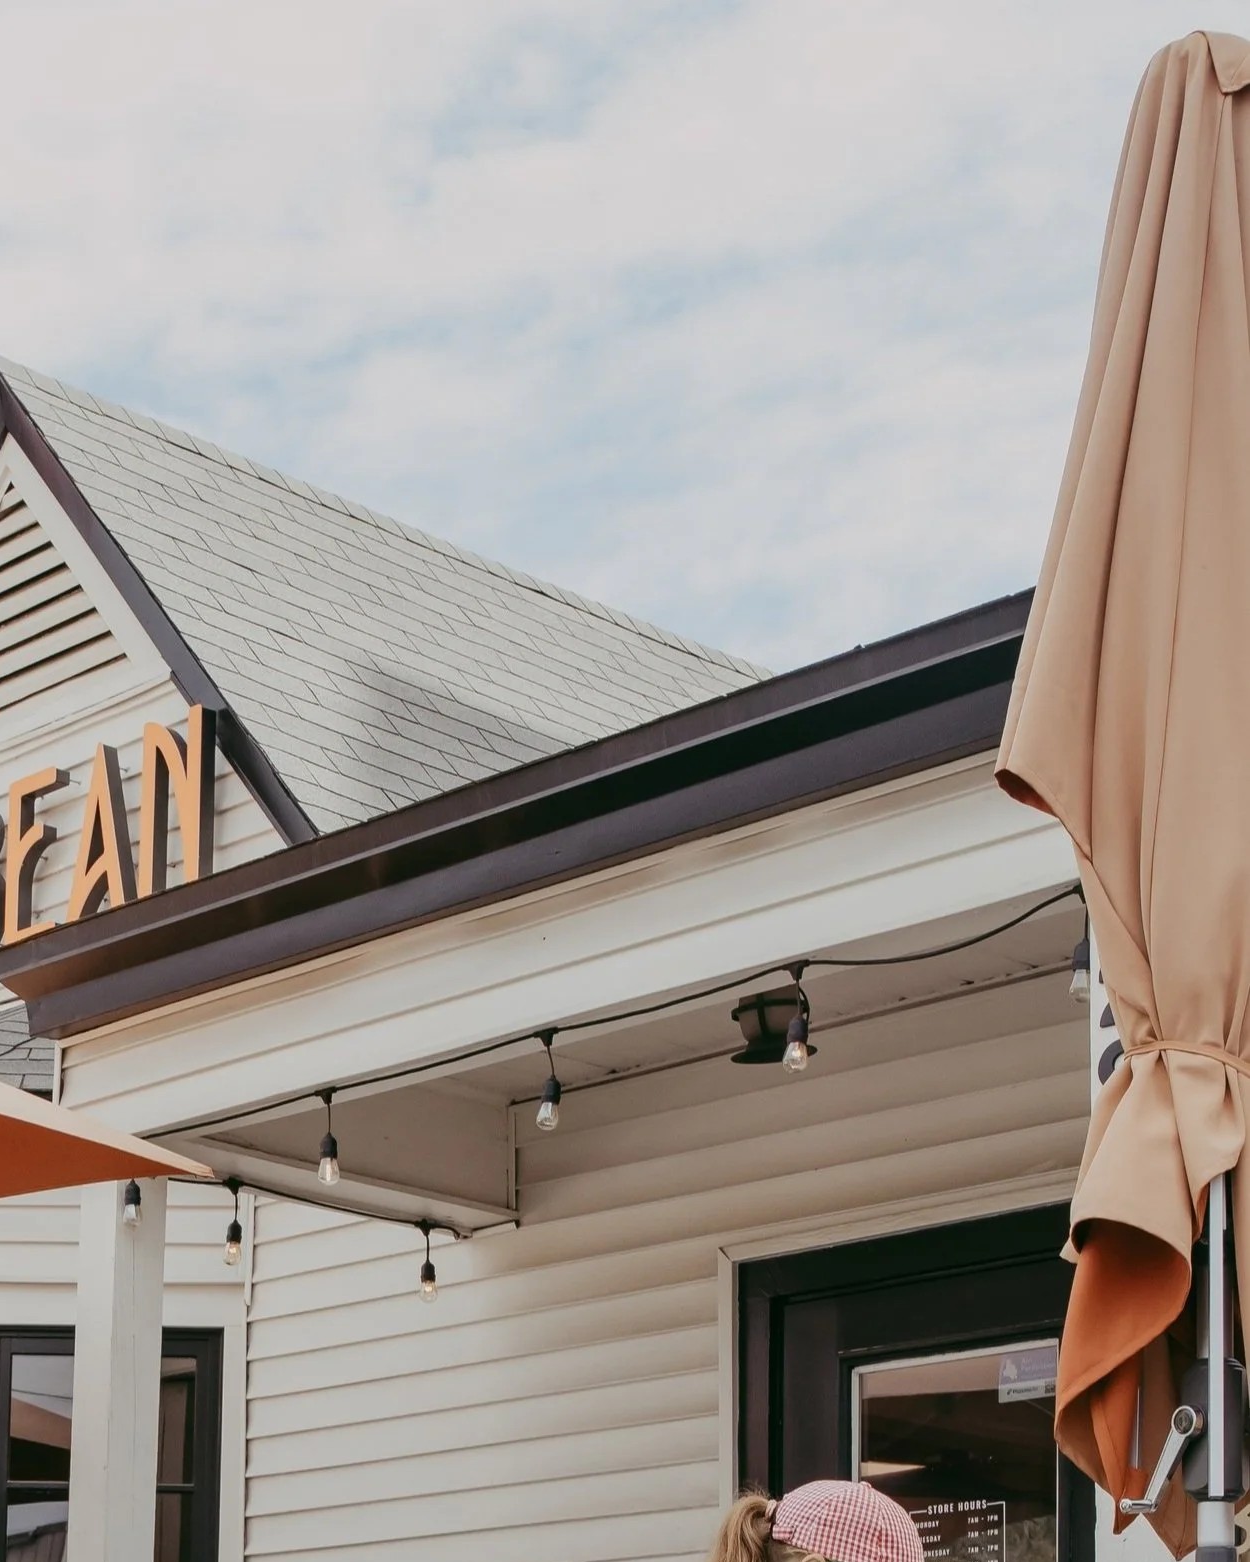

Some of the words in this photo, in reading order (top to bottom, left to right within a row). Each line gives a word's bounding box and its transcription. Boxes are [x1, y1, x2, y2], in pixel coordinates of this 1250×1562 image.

[927, 1503, 954, 1515] STORE
[958, 1499, 987, 1512] HOURS
[924, 1548, 950, 1557] DNESDAY
